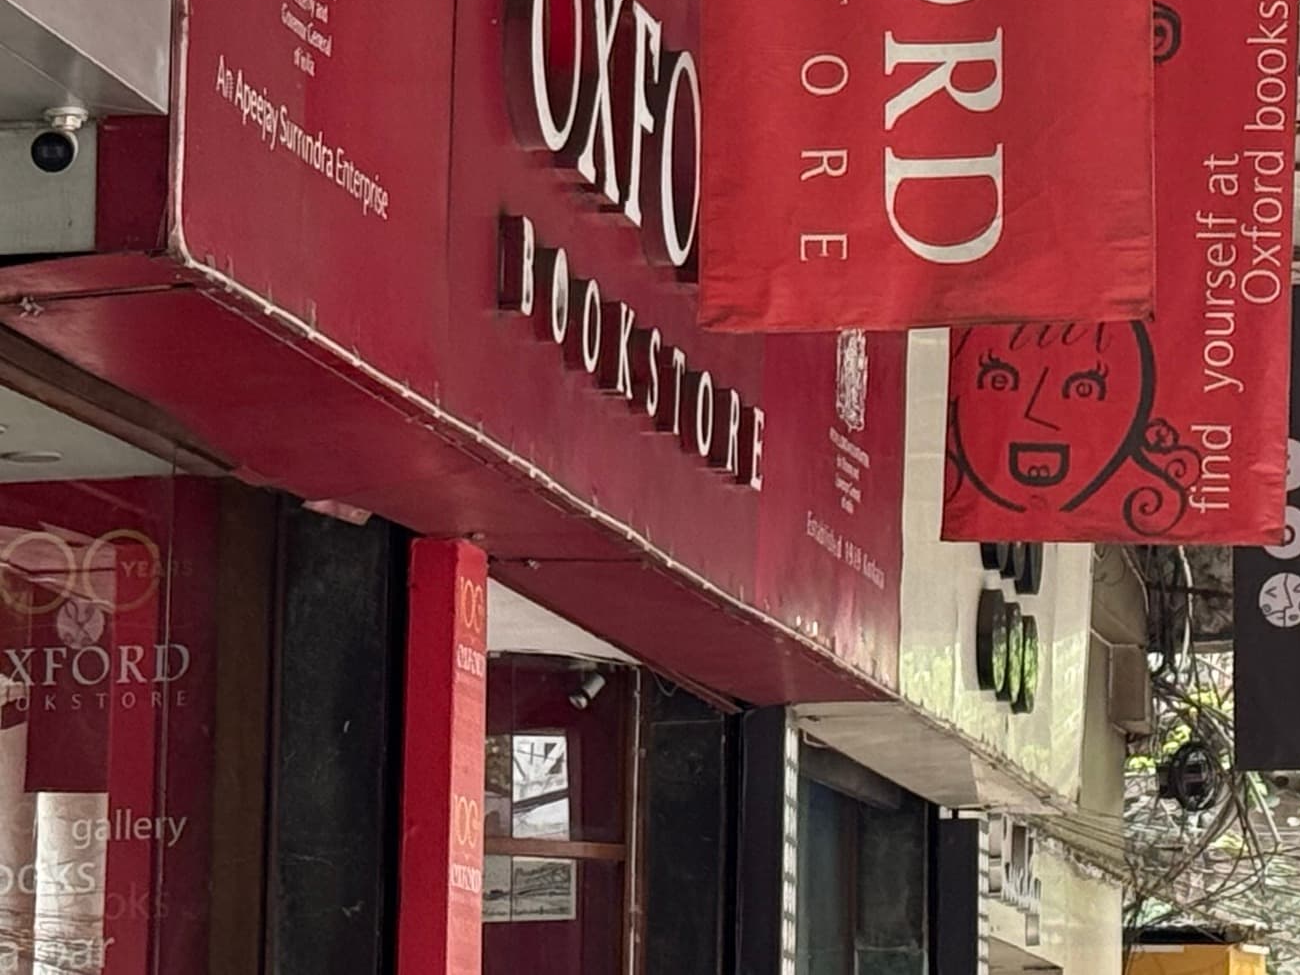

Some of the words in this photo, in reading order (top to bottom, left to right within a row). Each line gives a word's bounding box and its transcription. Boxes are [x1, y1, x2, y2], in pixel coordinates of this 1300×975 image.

[216, 54, 234, 102] An
[235, 69, 278, 151] Apeejay
[335, 148, 389, 220] Enterprise
[1203, 152, 1239, 196] at
[1240, 151, 1284, 304] Oxford
[1196, 210, 1244, 393] yourself
[521, 215, 765, 492] BOOKSTORE
[1188, 424, 1232, 514] find
[3, 643, 190, 687] XFORD
[16, 691, 188, 711] OKSTORE
[72, 809, 187, 850] gallery
[0, 862, 96, 895] ooks
